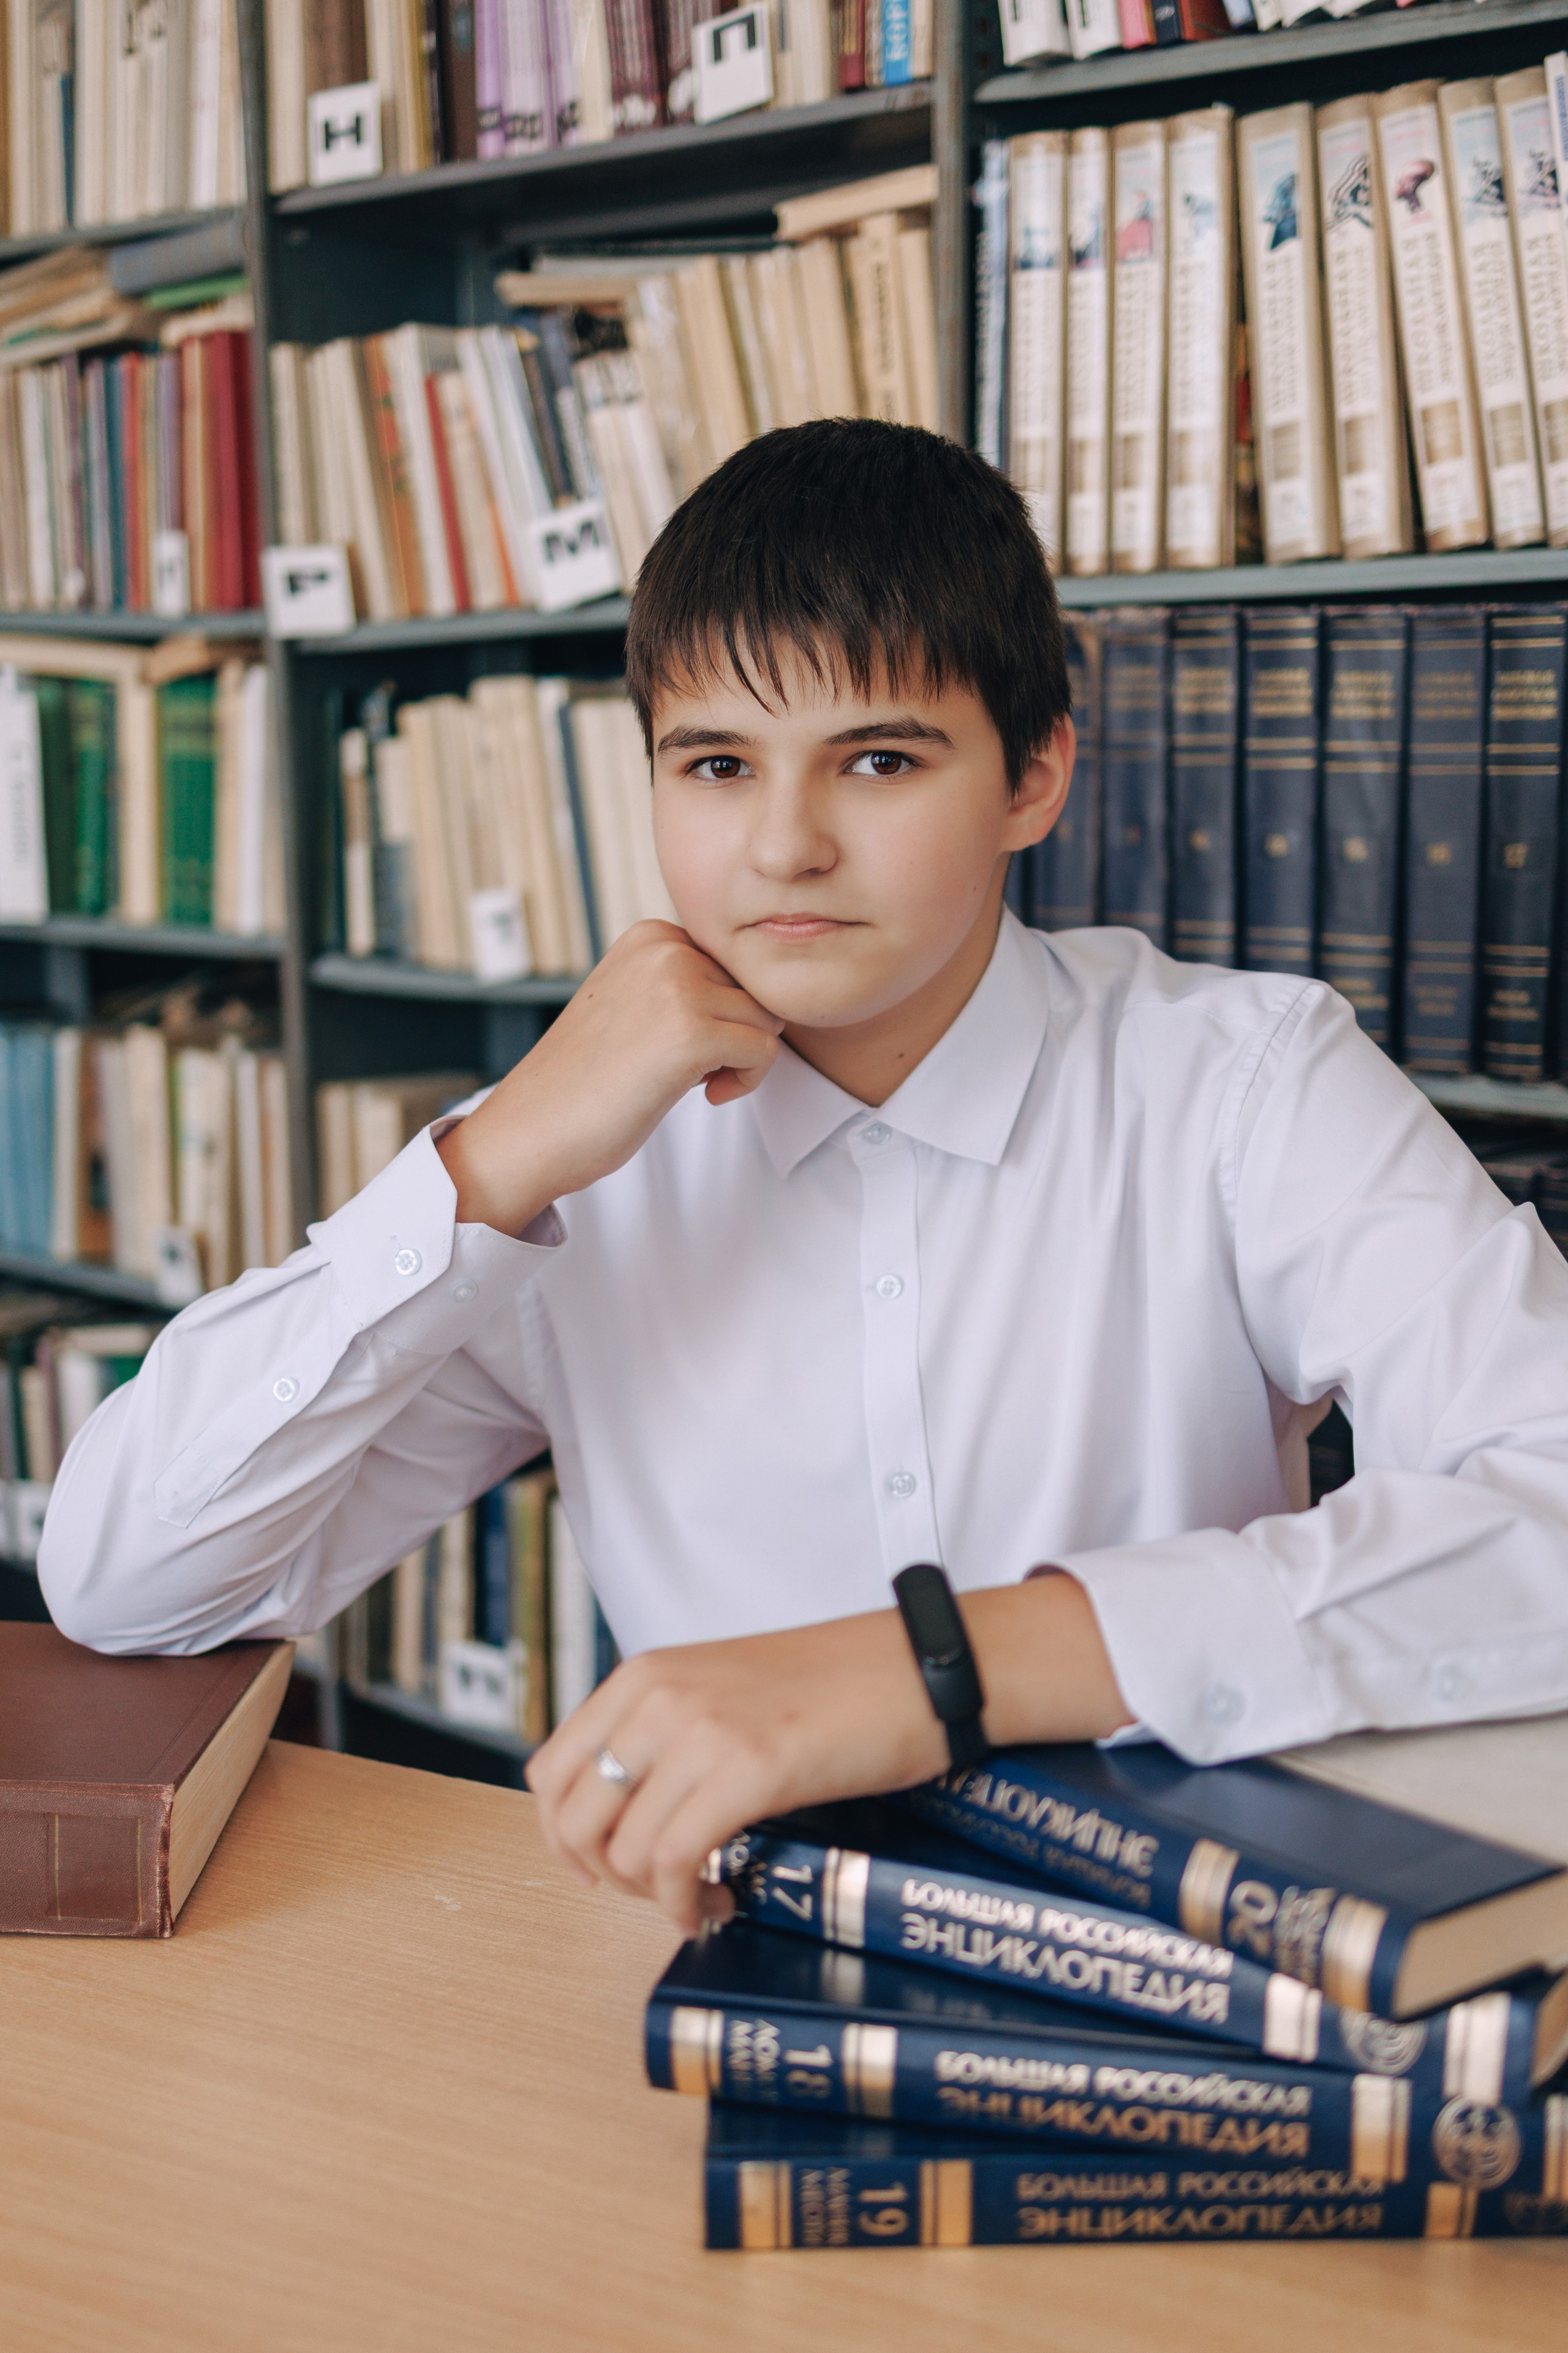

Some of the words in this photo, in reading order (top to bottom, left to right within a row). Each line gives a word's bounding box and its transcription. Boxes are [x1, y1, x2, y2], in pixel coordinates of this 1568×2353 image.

[712, 13, 756, 63] П
[324, 112, 362, 151] Н
[771, 1864, 814, 1922] 17
[900, 1878, 1035, 1933] БОЛЬШАЯ
[1038, 1908, 1235, 1979] РОССИЙСКАЯ
[899, 1911, 1231, 2025] ЭНЦИКЛОПЕДИЯ
[783, 2044, 832, 2099] 18
[934, 2050, 1091, 2095] БОЛЬШАЯ
[1093, 2065, 1313, 2119] РОССИЙСКАЯ
[935, 2085, 1310, 2159] ЭНЦИКЛОПЕДИЯ
[859, 2180, 908, 2237] 19
[1016, 2172, 1170, 2203] БОЛЬШАЯ
[1176, 2166, 1385, 2200] РОССИЙСКАЯ
[1016, 2203, 1384, 2240] ЭНЦИКЛОПЕДИЯ
